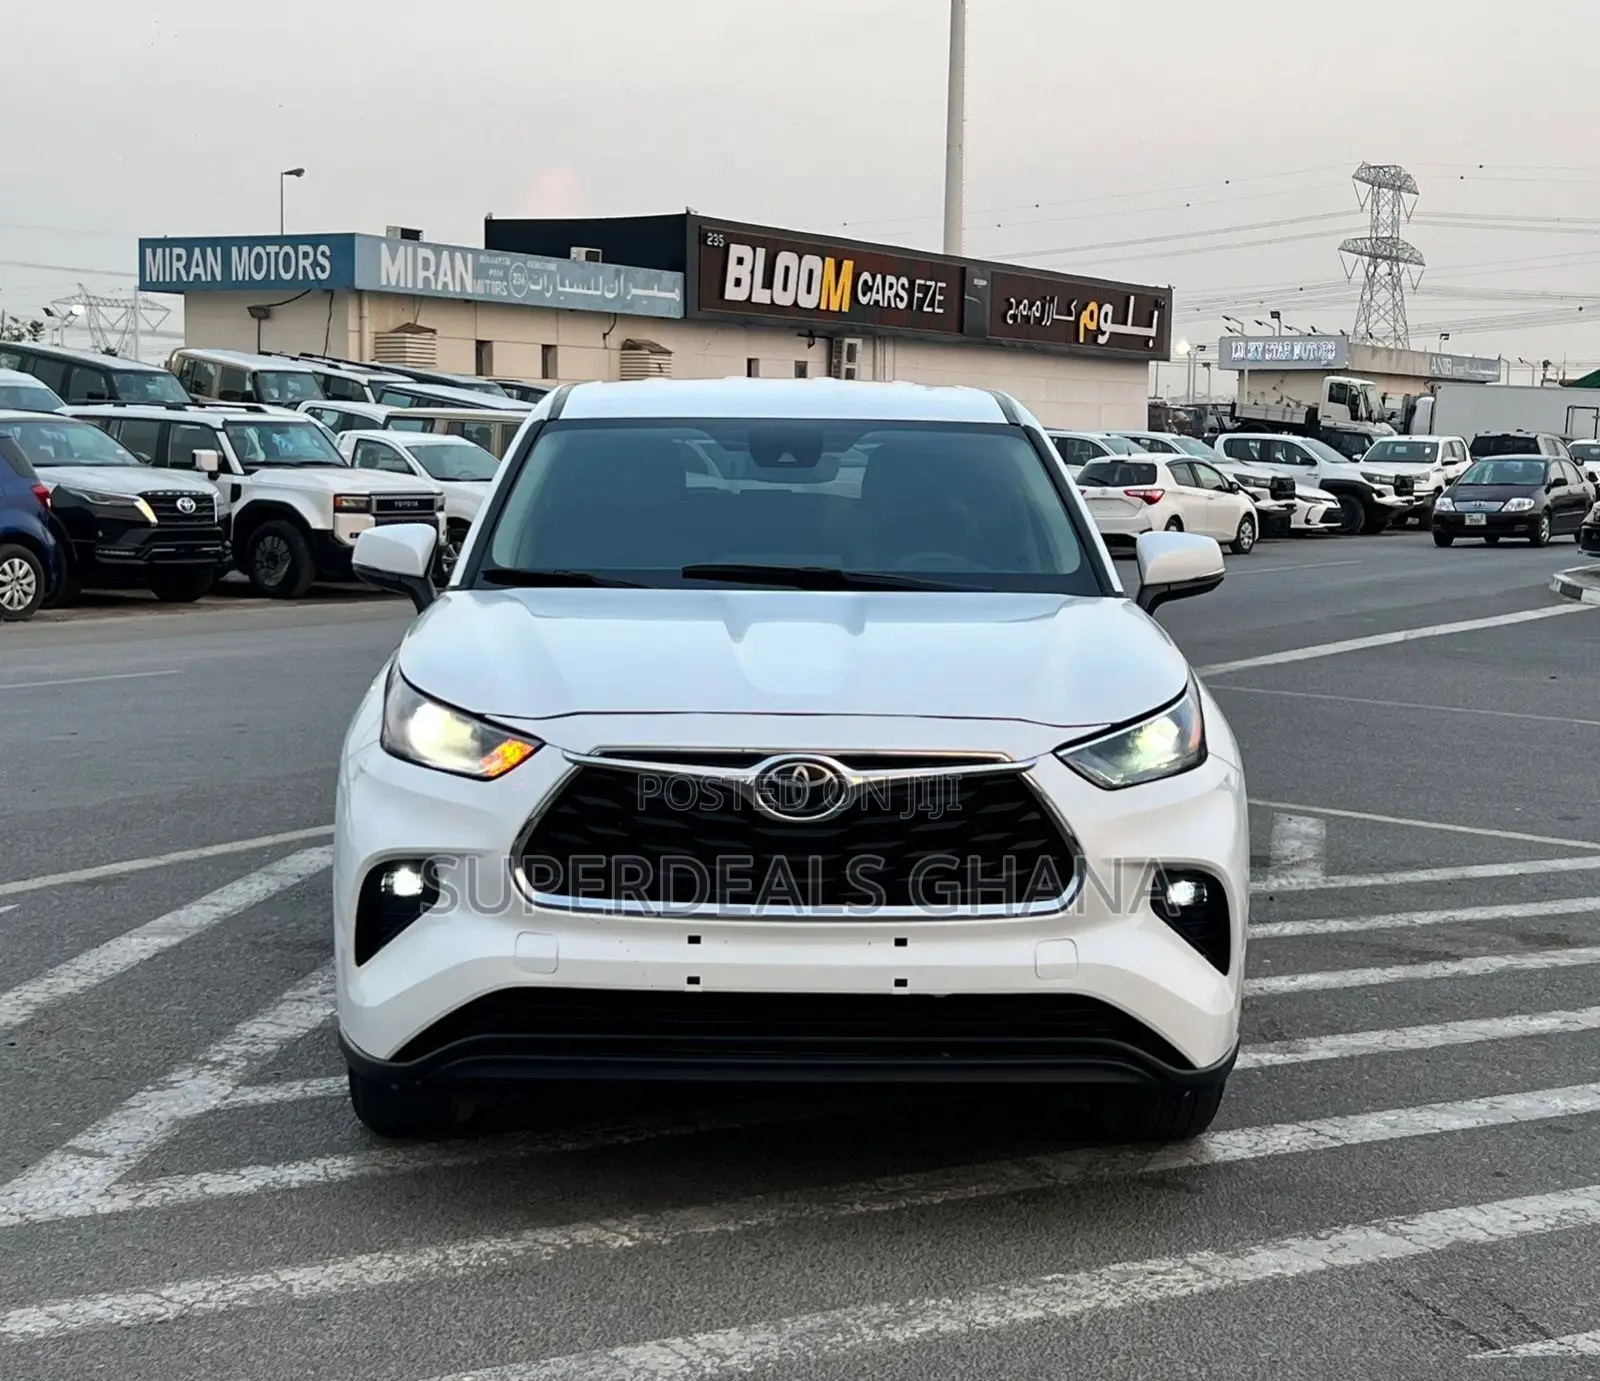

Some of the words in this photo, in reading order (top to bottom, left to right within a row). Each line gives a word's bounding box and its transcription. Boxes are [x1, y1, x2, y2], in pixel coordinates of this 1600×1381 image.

[145, 247, 222, 282] MIRAN
[231, 245, 331, 281] MOTORS
[707, 233, 724, 247] 235
[380, 243, 473, 293] MIRAN
[724, 244, 854, 312] BLOOM
[857, 271, 908, 309] CARS
[913, 279, 947, 313] FZE
[1079, 296, 1158, 348] بلوم
